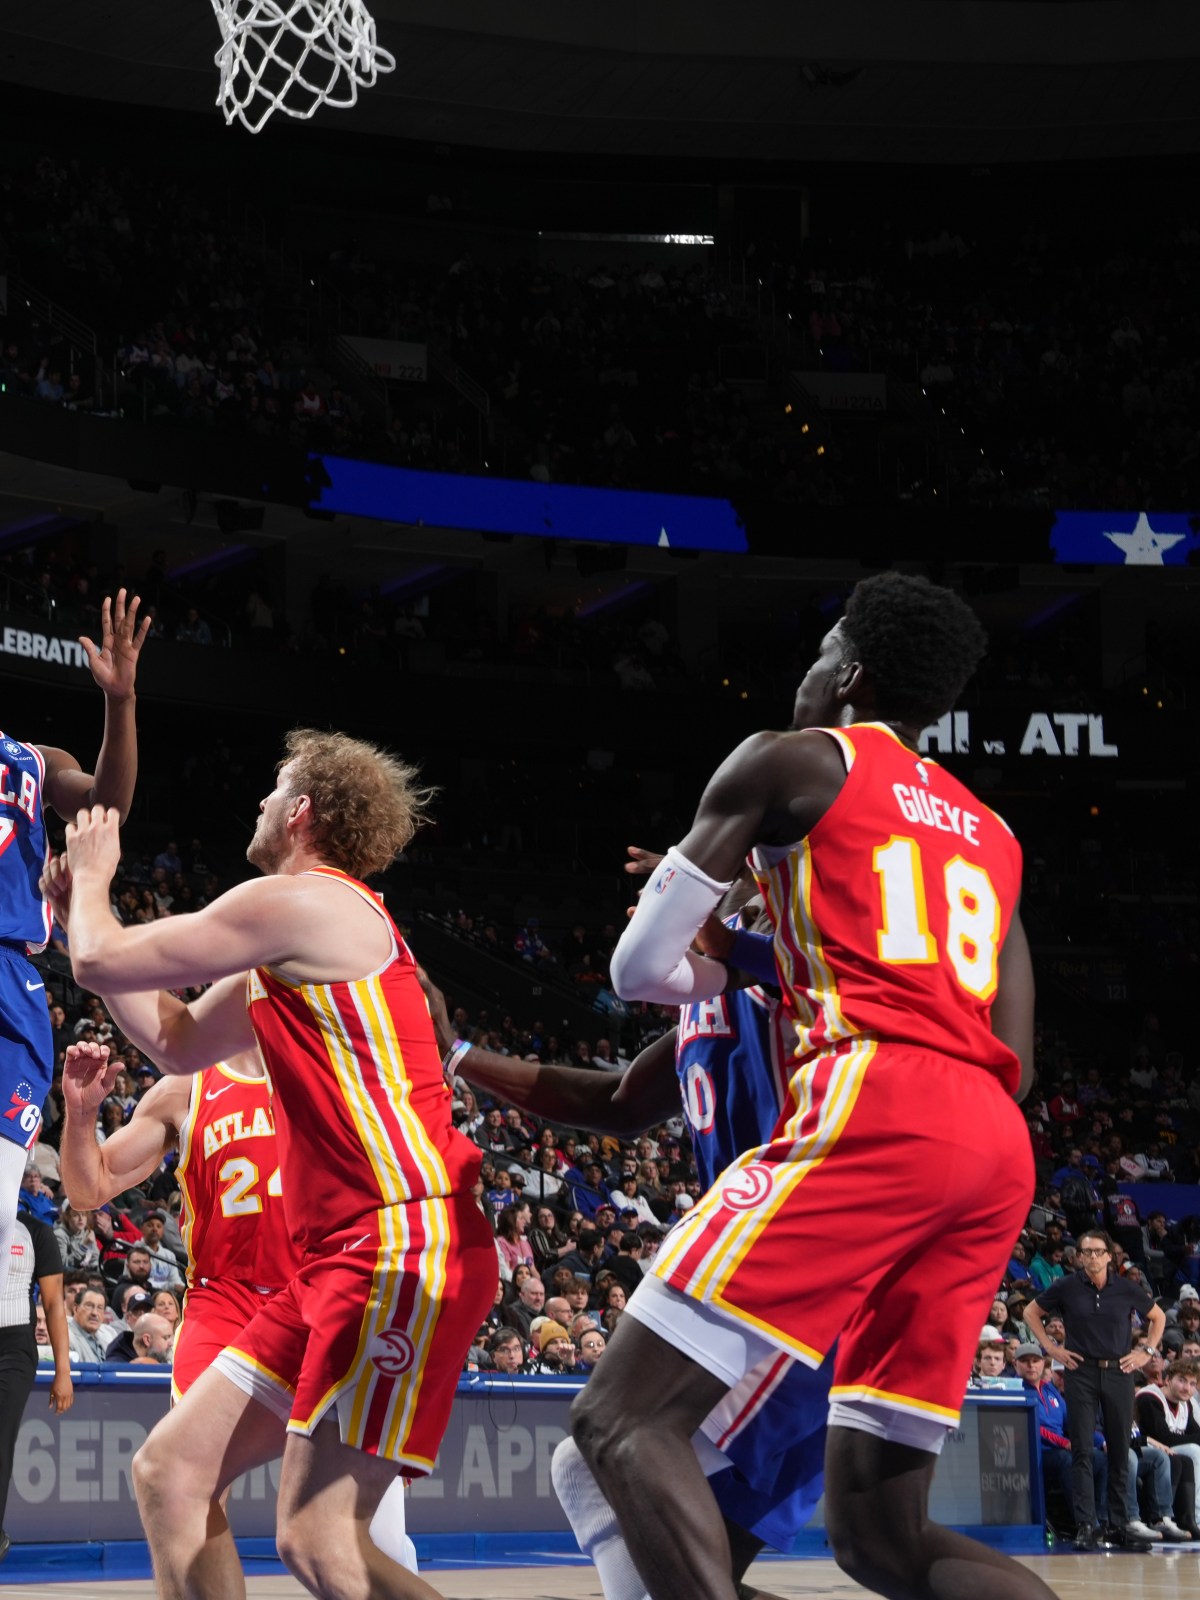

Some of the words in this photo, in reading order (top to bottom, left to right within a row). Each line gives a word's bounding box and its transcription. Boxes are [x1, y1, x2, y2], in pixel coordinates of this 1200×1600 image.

[917, 710, 970, 755] HI
[982, 739, 1007, 755] vs
[1018, 711, 1120, 758] ATL
[892, 783, 980, 846] GUEYE
[872, 834, 1001, 1001] 18
[3, 1091, 41, 1133] 76
[681, 1062, 717, 1133] 0
[203, 1107, 277, 1161] ATLA
